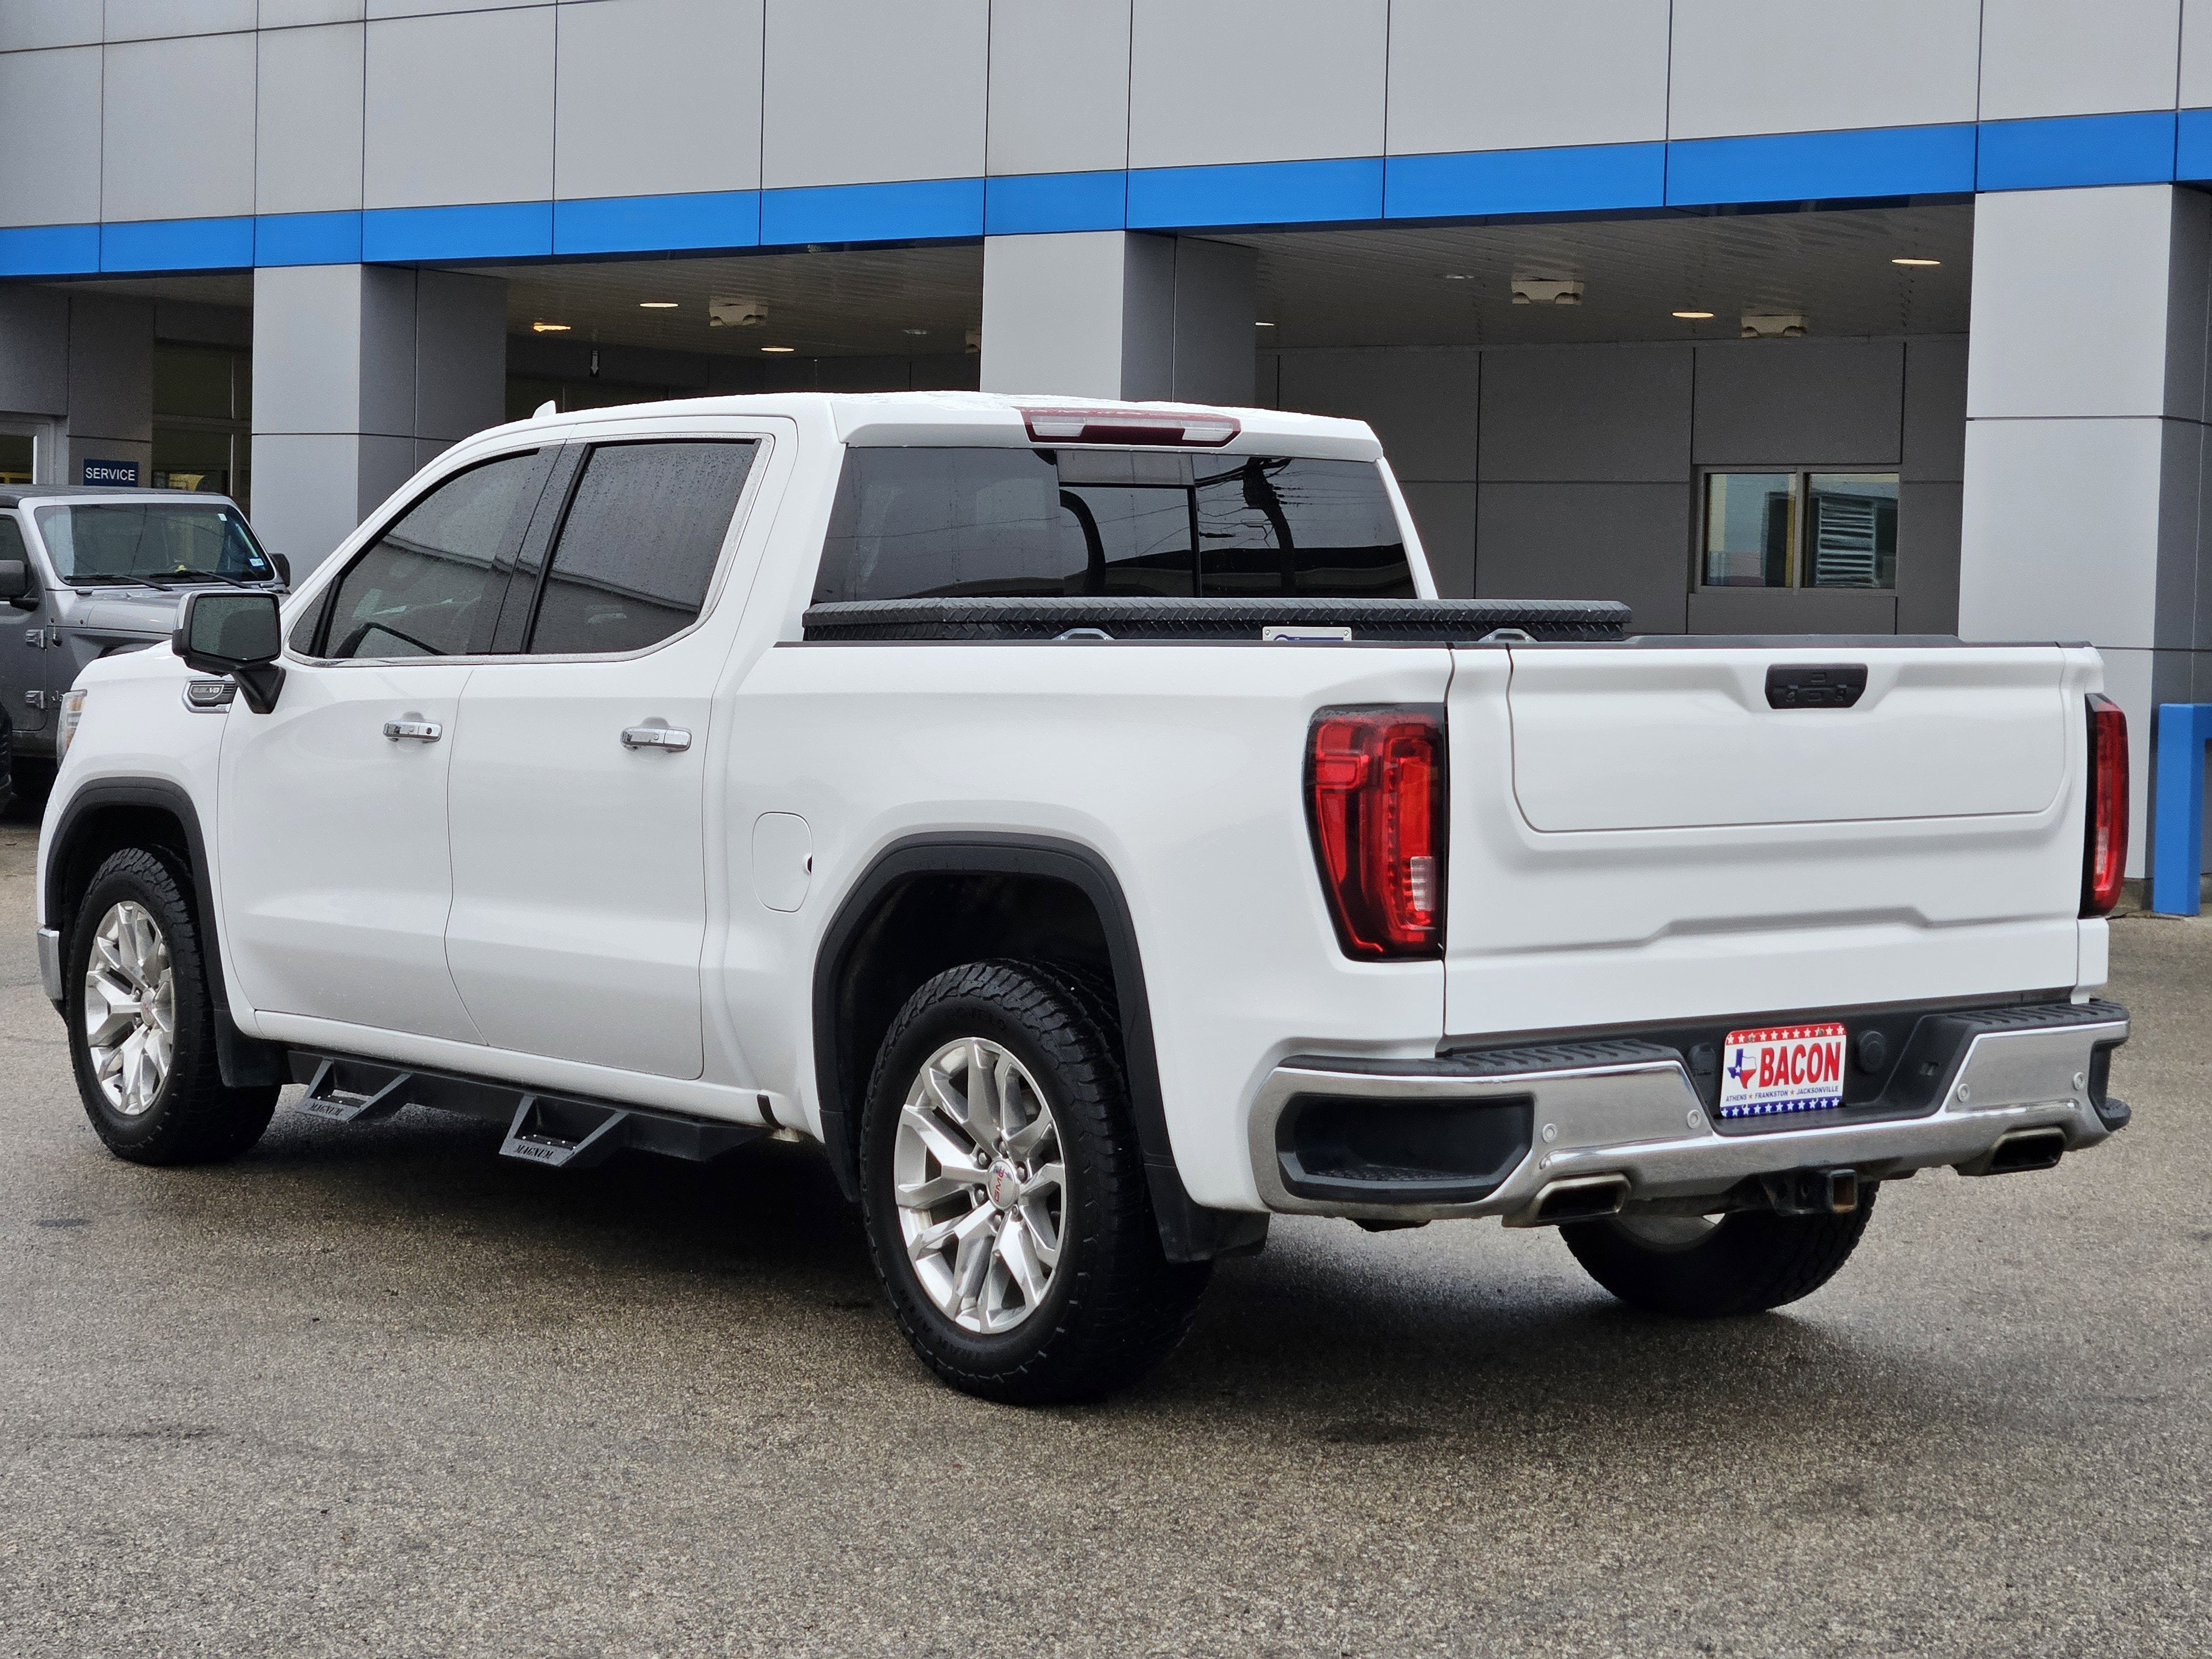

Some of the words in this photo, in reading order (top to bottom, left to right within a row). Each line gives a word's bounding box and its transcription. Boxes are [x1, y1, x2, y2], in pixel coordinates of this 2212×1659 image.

[85, 467, 135, 481] SERVICE
[1758, 1041, 1841, 1088] BACON
[1725, 1093, 1747, 1102] ATHENS
[1755, 1089, 1788, 1099] FRANKSTON
[1796, 1085, 1839, 1095] JACKSONVILLE
[309, 1102, 344, 1116] MAGNUM
[515, 1144, 554, 1159] MAGNUM
[994, 1166, 1005, 1202] GMC
